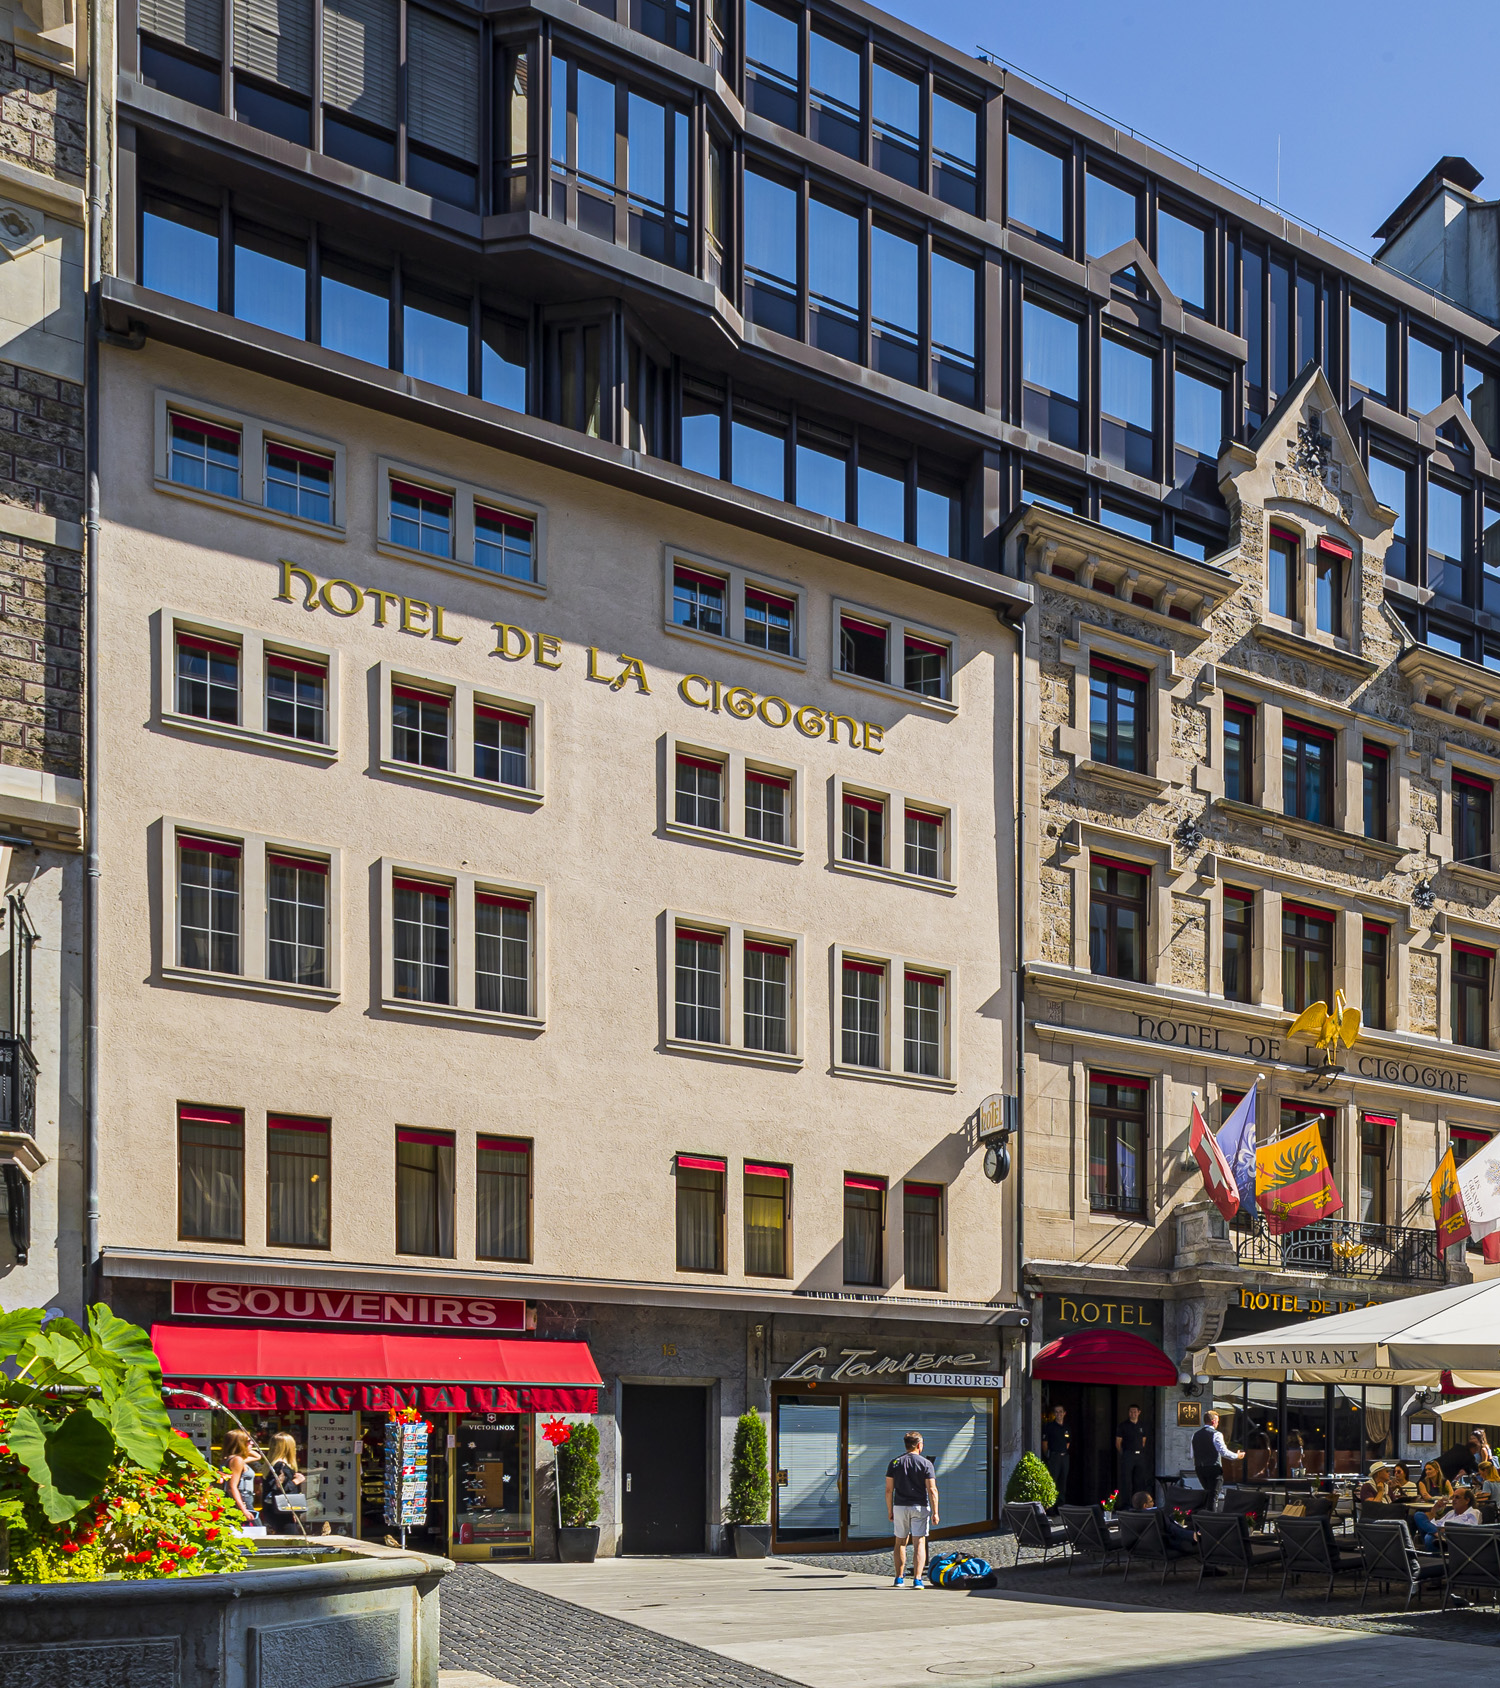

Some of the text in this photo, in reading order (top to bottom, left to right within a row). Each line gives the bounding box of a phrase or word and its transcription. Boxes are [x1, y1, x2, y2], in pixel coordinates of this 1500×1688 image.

[279, 559, 886, 754] HOTEL DE LA CIGOGNE
[1132, 1011, 1229, 1052] HOTEL
[1245, 1035, 1281, 1061] DE
[1358, 1056, 1469, 1093] CIGOGNE
[207, 1287, 497, 1326] SOUVENIRS
[1059, 1297, 1152, 1327] HOTEL
[1240, 1289, 1303, 1313] HOTEL
[1310, 1300, 1331, 1314] DE
[662, 1343, 677, 1357] 15
[779, 1346, 827, 1381] La
[1234, 1350, 1359, 1365] RESTAURANT
[913, 1374, 999, 1388] FOURRURES
[226, 1382, 532, 1411] LONGEMALLE
[468, 1424, 515, 1432] VICTORINOX
